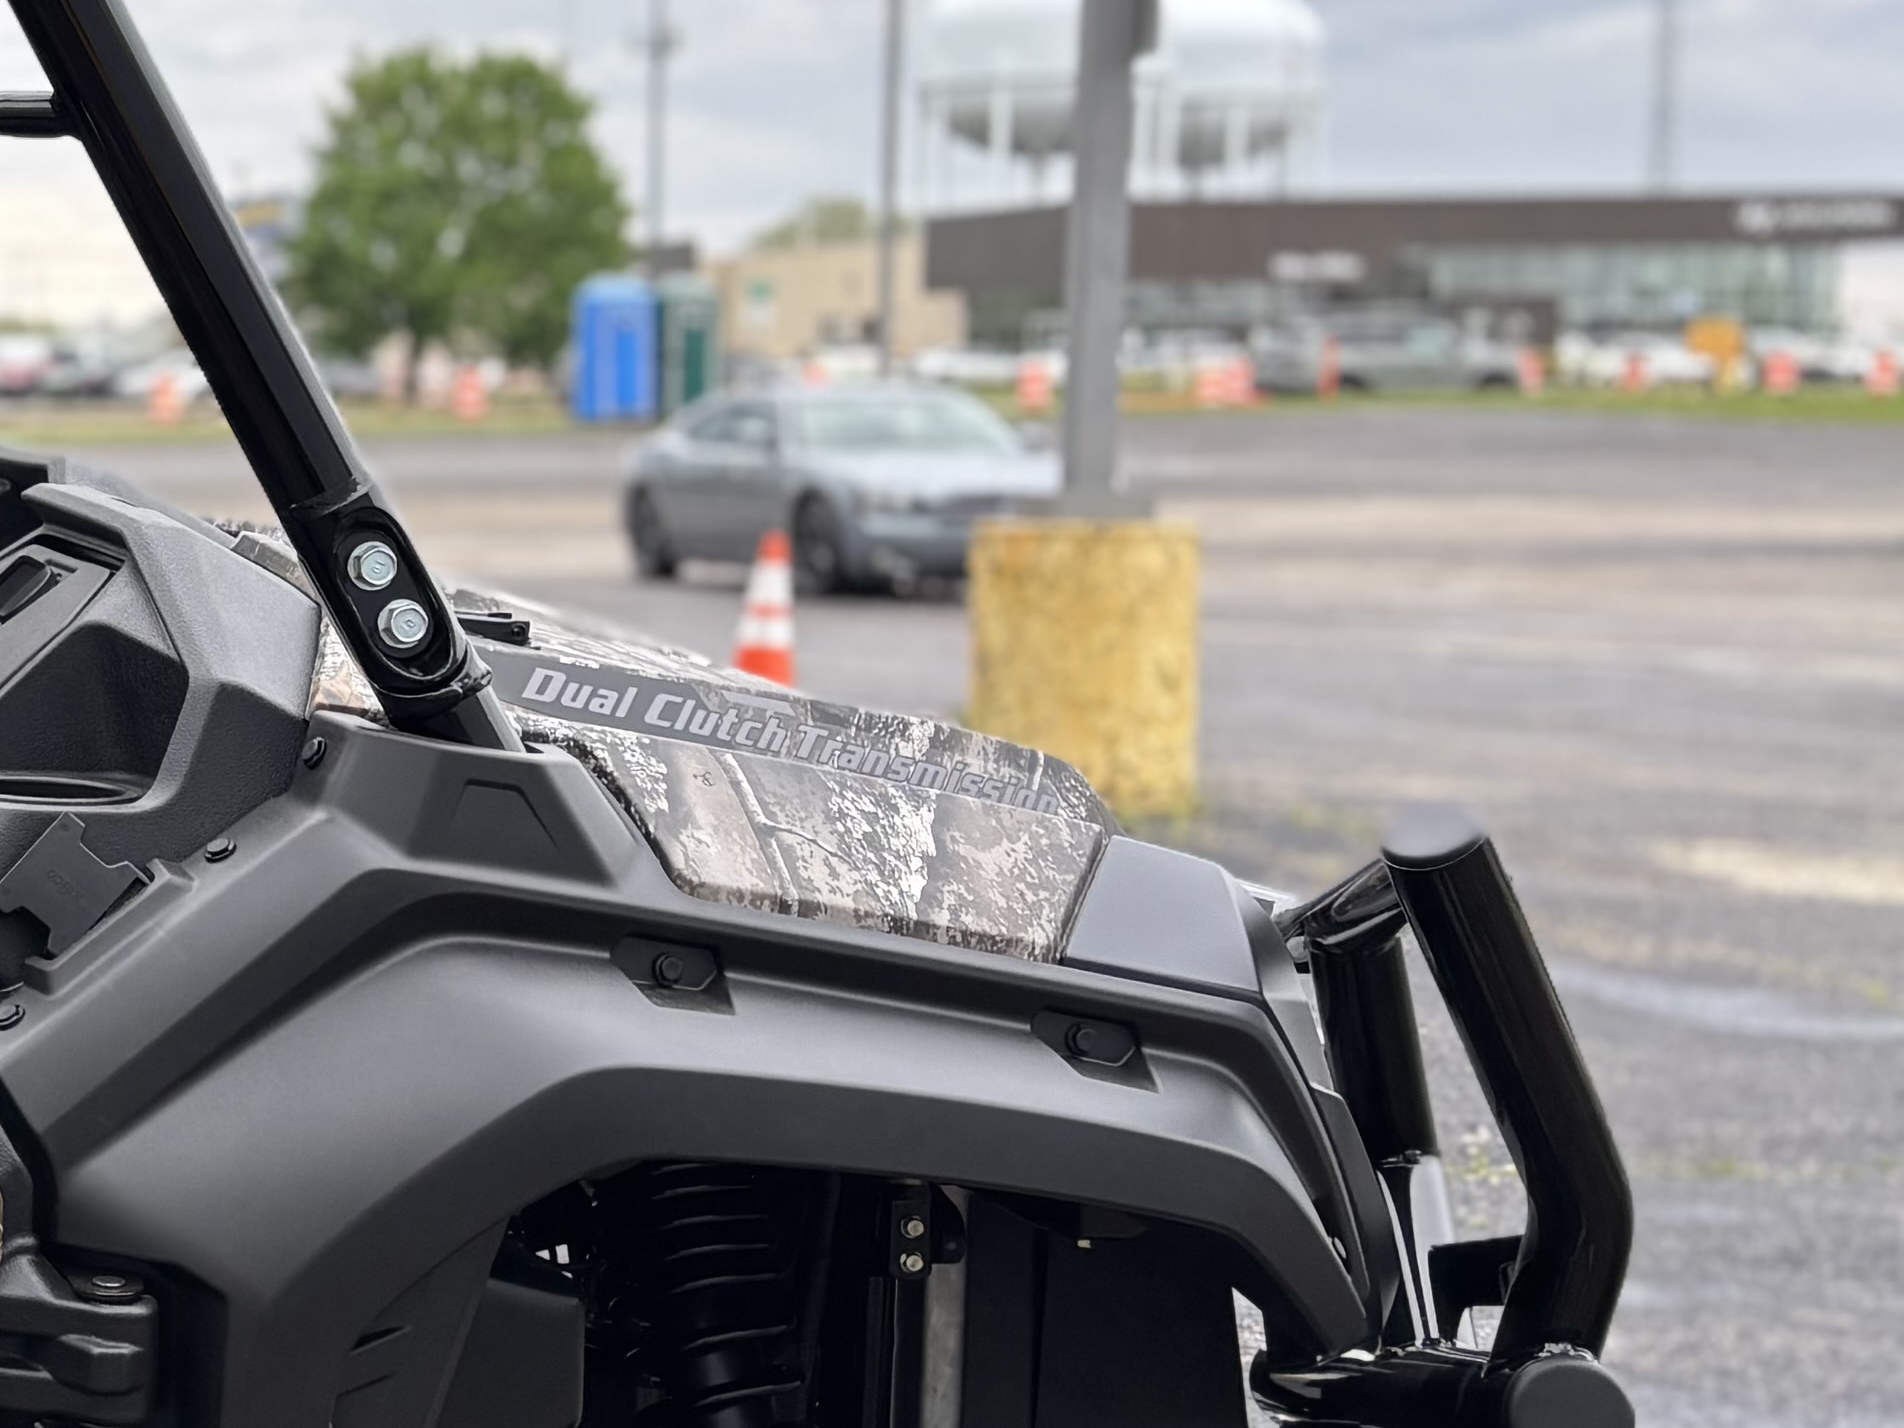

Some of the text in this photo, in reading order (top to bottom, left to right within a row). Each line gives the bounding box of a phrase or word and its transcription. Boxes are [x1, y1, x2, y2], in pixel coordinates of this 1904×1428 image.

[522, 667, 1061, 814] Dual Clutch Transmission
